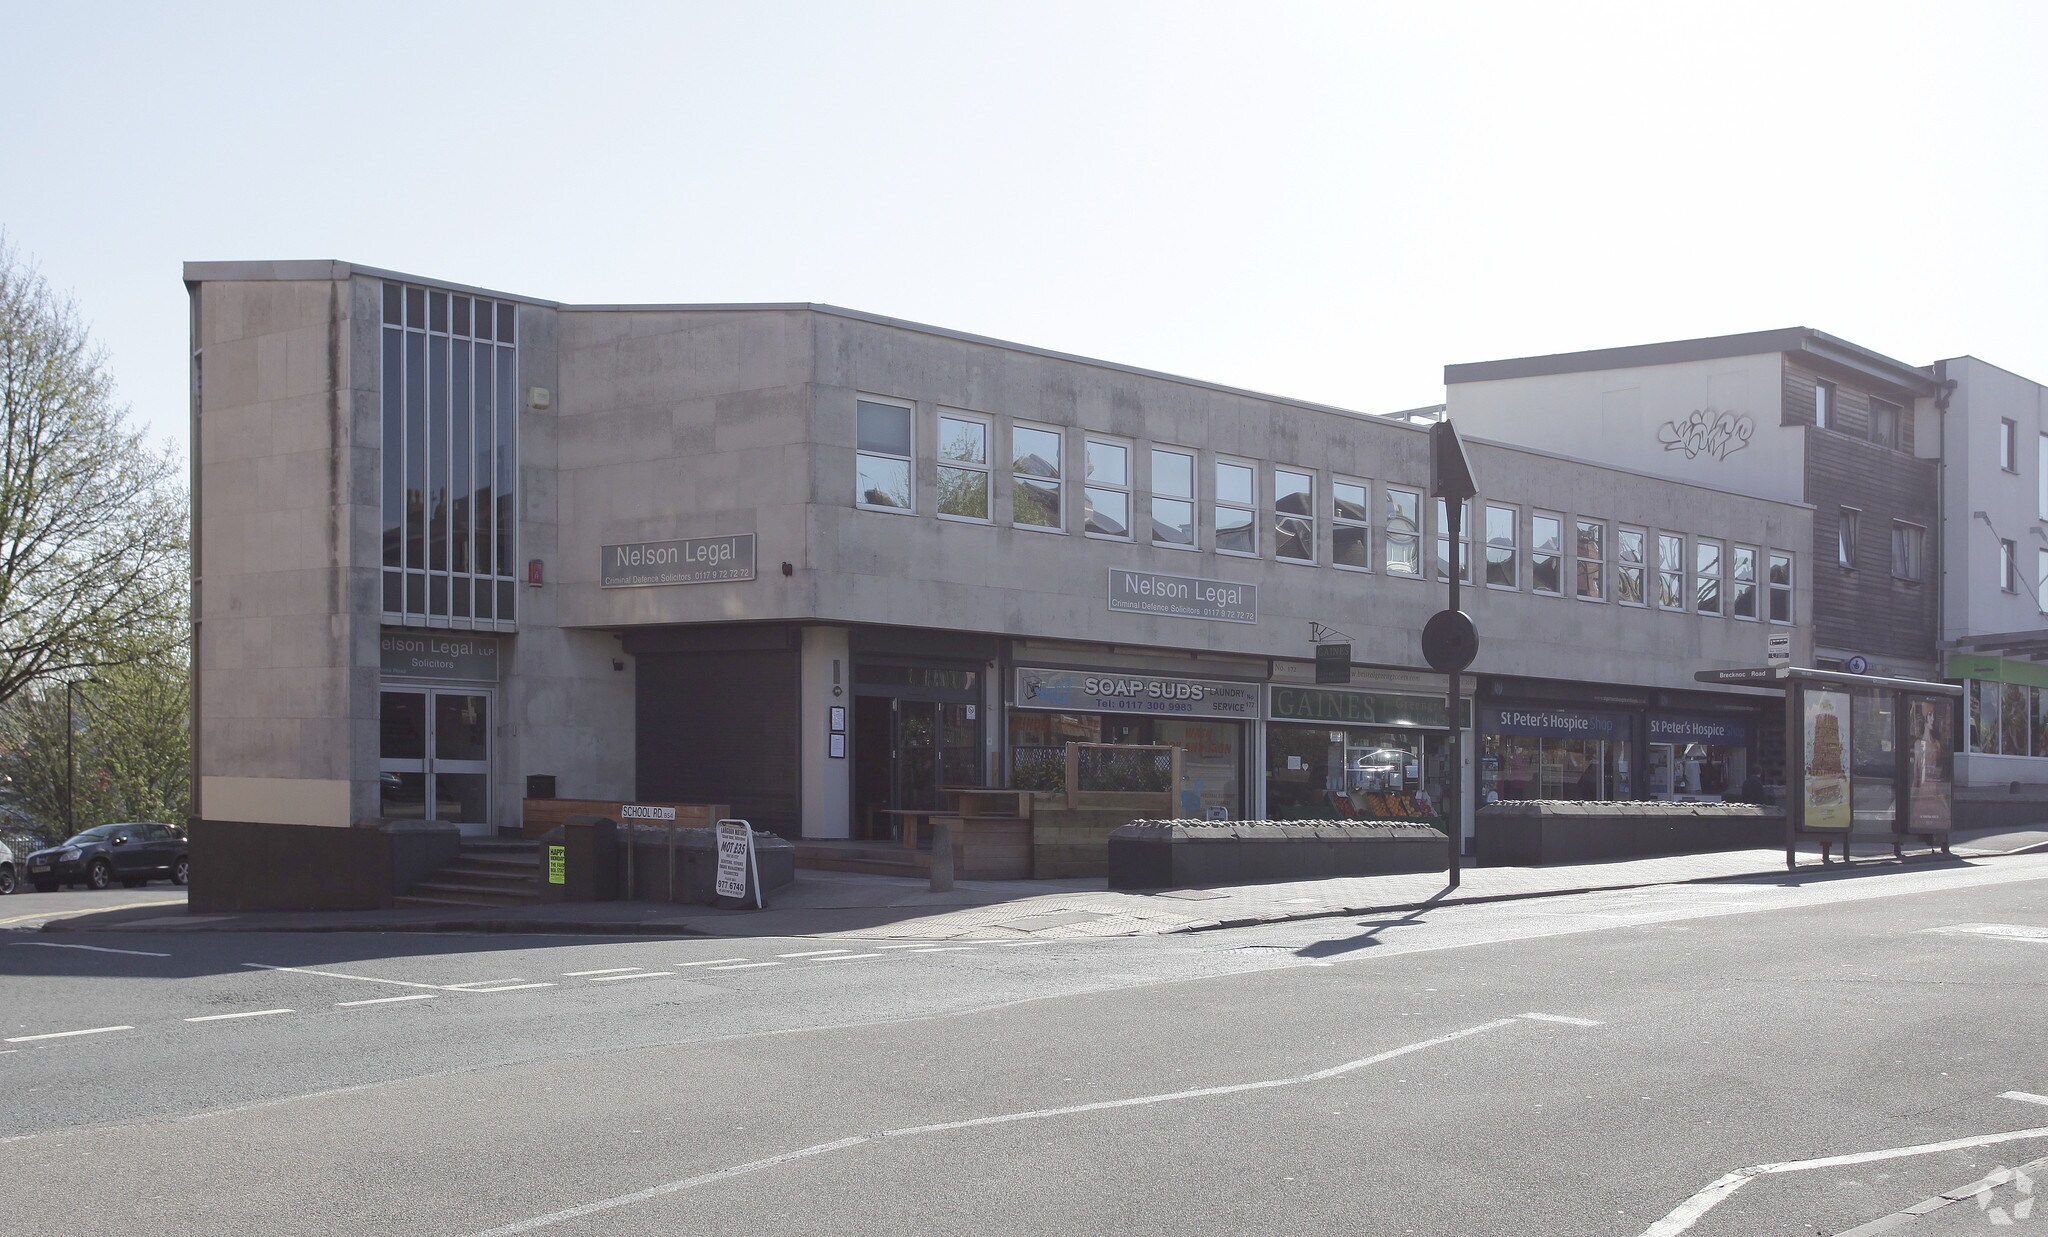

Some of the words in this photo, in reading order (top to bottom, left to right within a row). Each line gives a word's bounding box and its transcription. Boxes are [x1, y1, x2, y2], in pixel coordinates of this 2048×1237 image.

[617, 545, 678, 566] Nelson
[686, 538, 736, 566] Legal
[605, 576, 632, 585] Criminal
[633, 575, 659, 584] Defence
[661, 573, 691, 582] Solicitors
[695, 572, 710, 580] 0117
[719, 570, 727, 578] 72
[730, 569, 738, 577] 72
[740, 569, 749, 577] 72
[1126, 573, 1188, 599] Nelson
[1196, 582, 1242, 608] Legal
[1112, 599, 1140, 609] Criminal
[1142, 602, 1168, 612] Defence
[1171, 605, 1200, 615] Solicitors
[1204, 608, 1219, 616] 0117
[1227, 610, 1235, 618] 72
[1237, 611, 1244, 619] 72
[1246, 612, 1254, 620] 72
[381, 636, 424, 652] elson
[431, 639, 473, 657] Legal
[479, 648, 495, 656] LLP
[1318, 647, 1349, 657] GAINES
[412, 658, 454, 668] Solicitors
[1084, 677, 1144, 697] SOAP
[1148, 681, 1204, 701] SUDS
[1210, 688, 1245, 698] LAUNDRY
[1096, 699, 1115, 708] Tel:
[1119, 700, 1143, 710] 0117
[1147, 702, 1165, 711] 300
[1168, 703, 1192, 712] 9983
[1213, 702, 1245, 712] SERVICE
[1278, 690, 1376, 722] GAINES
[1501, 712, 1511, 725] St
[1514, 712, 1548, 727] Peter's
[1550, 715, 1588, 732] Hospice
[1590, 716, 1613, 733] Shop
[1651, 720, 1660, 732] St
[1662, 720, 1691, 734] Peter's
[1693, 723, 1725, 738] Hospice
[623, 806, 650, 817] SCHOOL
[721, 841, 734, 853] MOT
[734, 843, 745, 855] £35
[718, 880, 728, 888] 977
[729, 882, 744, 891] 6740
